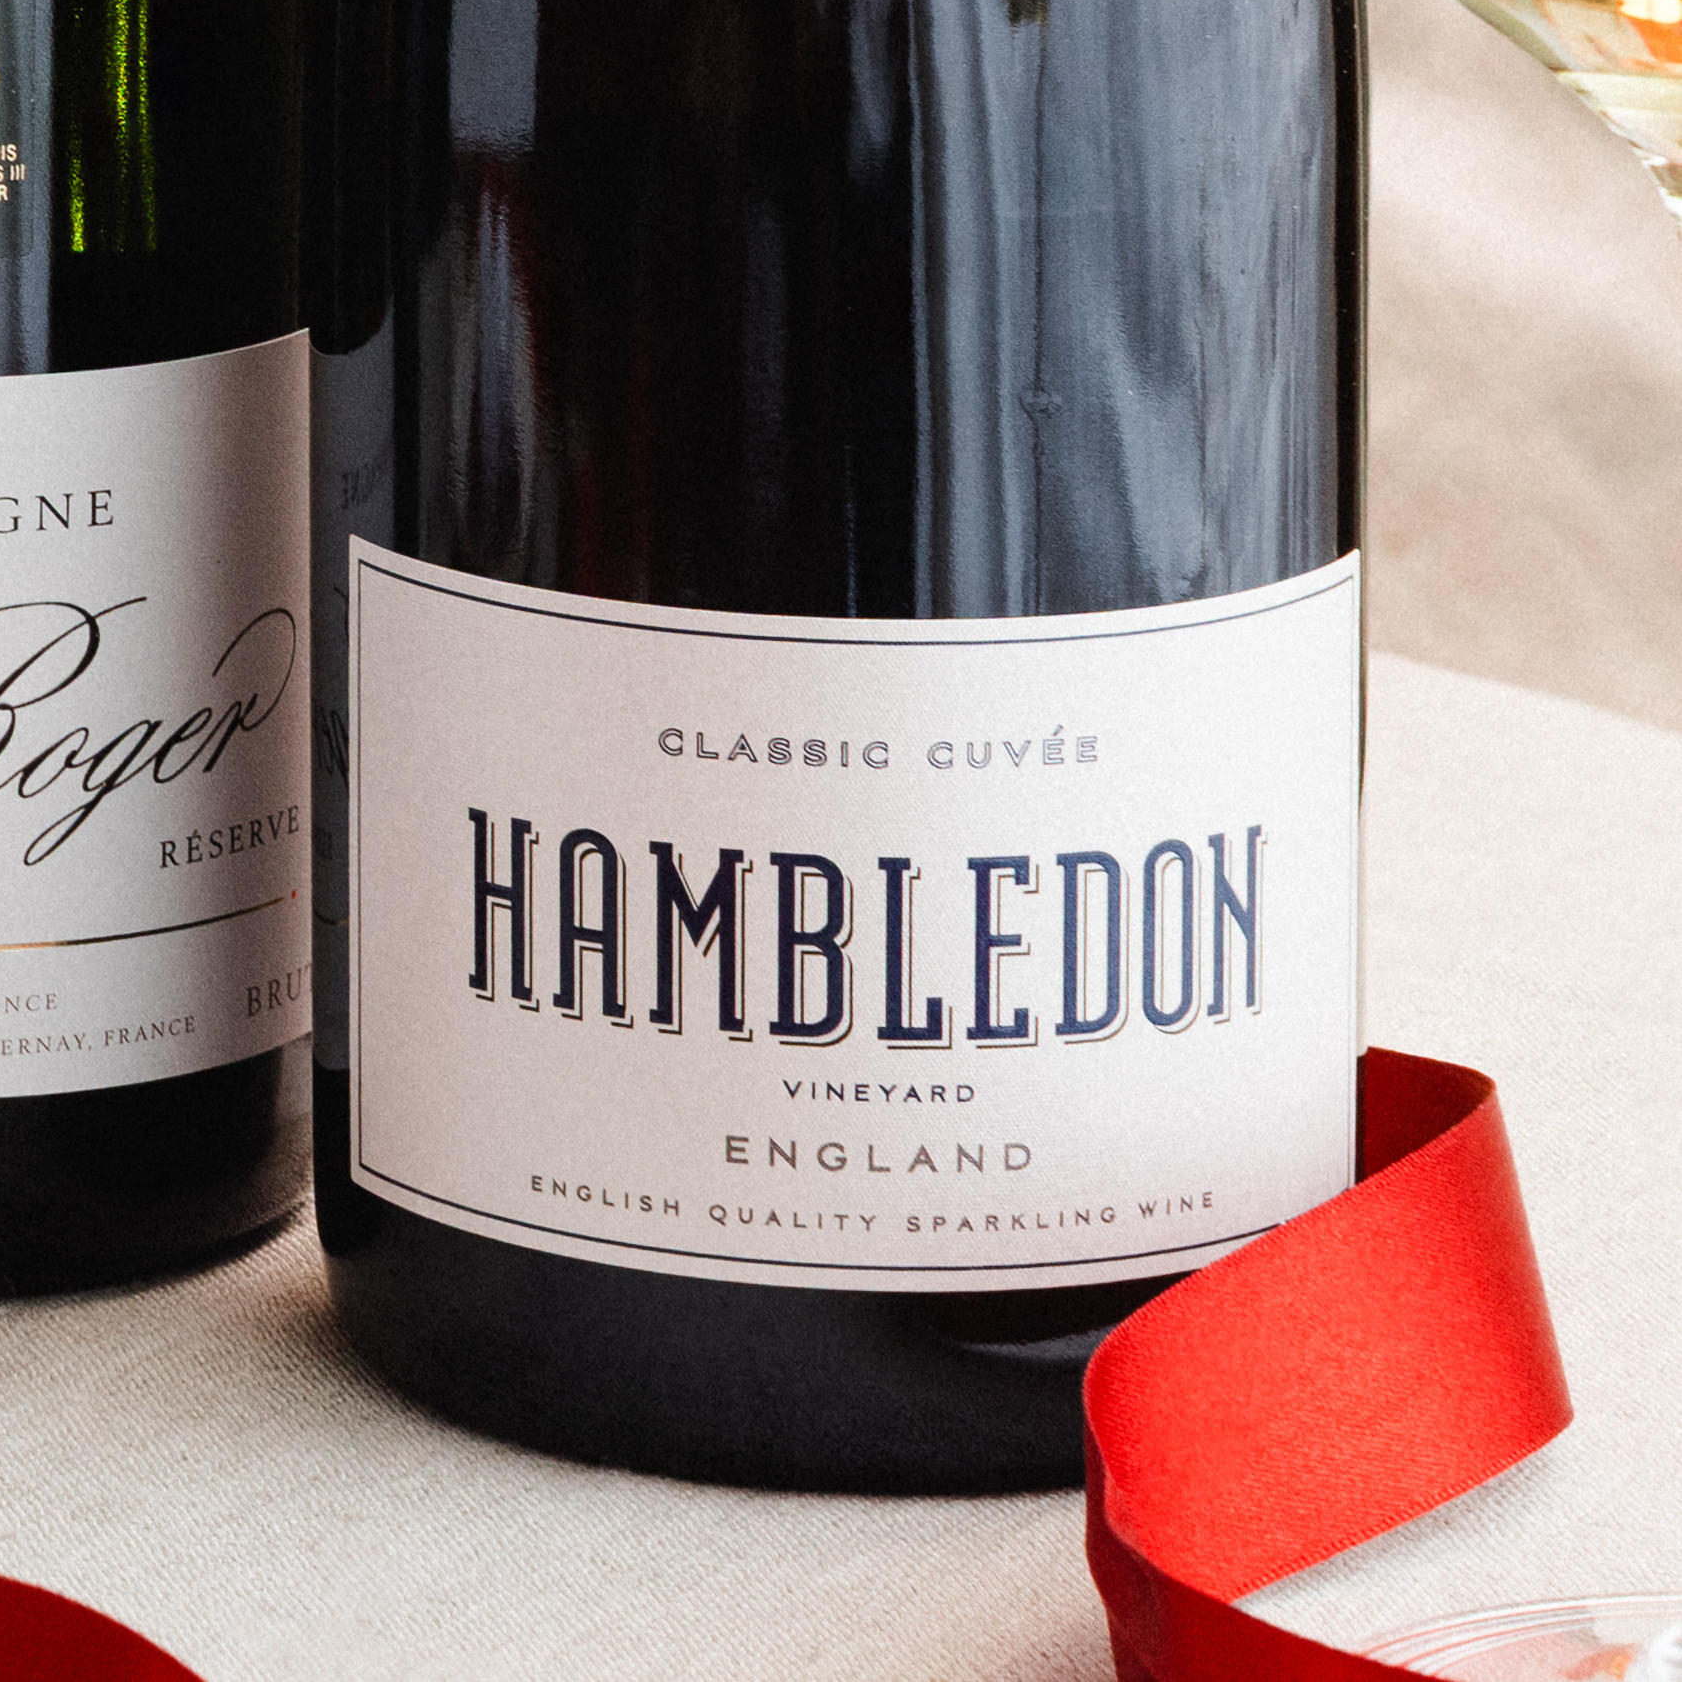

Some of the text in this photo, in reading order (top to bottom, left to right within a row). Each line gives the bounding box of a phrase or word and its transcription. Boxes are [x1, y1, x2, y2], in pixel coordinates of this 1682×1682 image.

[10, 164, 26, 181] III
[658, 724, 1101, 769] CLASSIC CUVÉE
[159, 803, 300, 869] RÉSERVE
[468, 807, 1268, 1049] HAMBLEDON
[104, 1015, 196, 1047] FRANCE
[783, 1079, 976, 1103] VINEYARD
[725, 1135, 1034, 1174] ENGLAND
[531, 1175, 1216, 1233] ENGLISH QUALITY SPARKLING WINE
